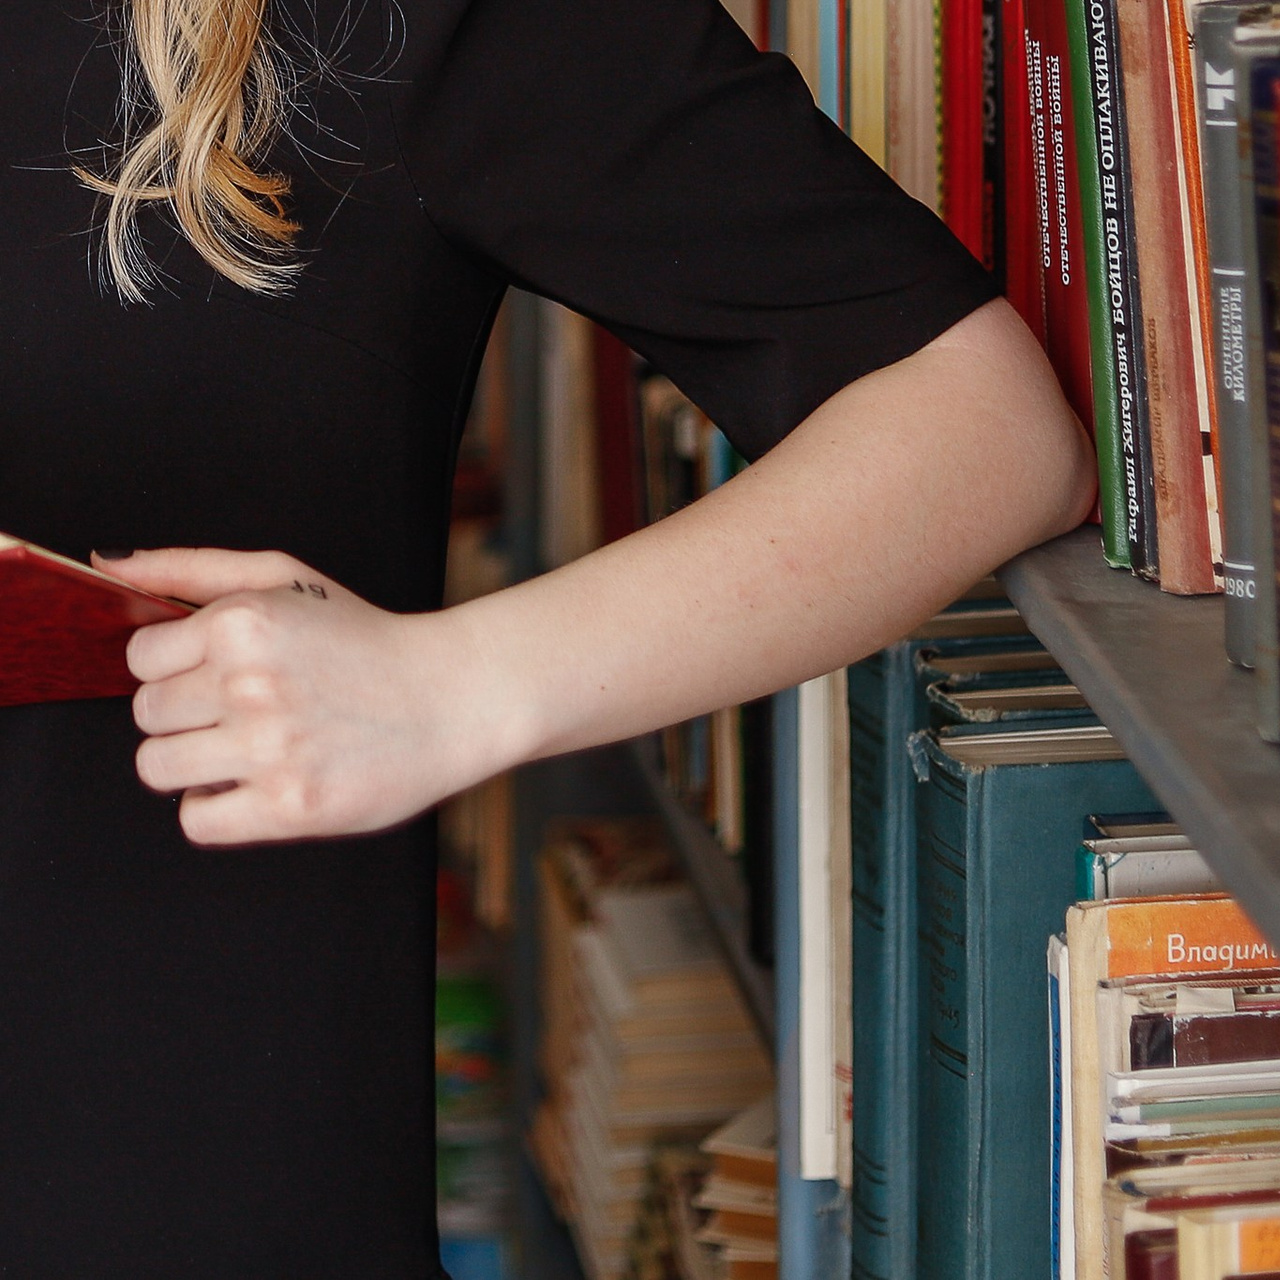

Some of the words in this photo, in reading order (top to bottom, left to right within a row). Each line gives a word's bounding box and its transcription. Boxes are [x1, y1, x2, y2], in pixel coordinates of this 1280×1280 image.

[1032, 40, 1043, 109] ВОЙНЫ
[1050, 55, 1062, 125] ВОЙНЫ
[1036, 114, 1051, 269] ОТЕЧЕСТВЕННОЙ
[1053, 129, 1070, 286] ОТЕЧЕСТВЕННОЙ
[1104, 173, 1118, 212] НЕ
[1107, 217, 1125, 326] БОЙЦОВ
[1221, 286, 1233, 390] ОГНЕННЫЕ
[1229, 286, 1246, 403] КИЛОМЕТРЫ
[1116, 332, 1135, 453] Хигерович
[1124, 455, 1138, 542] Рафаил
